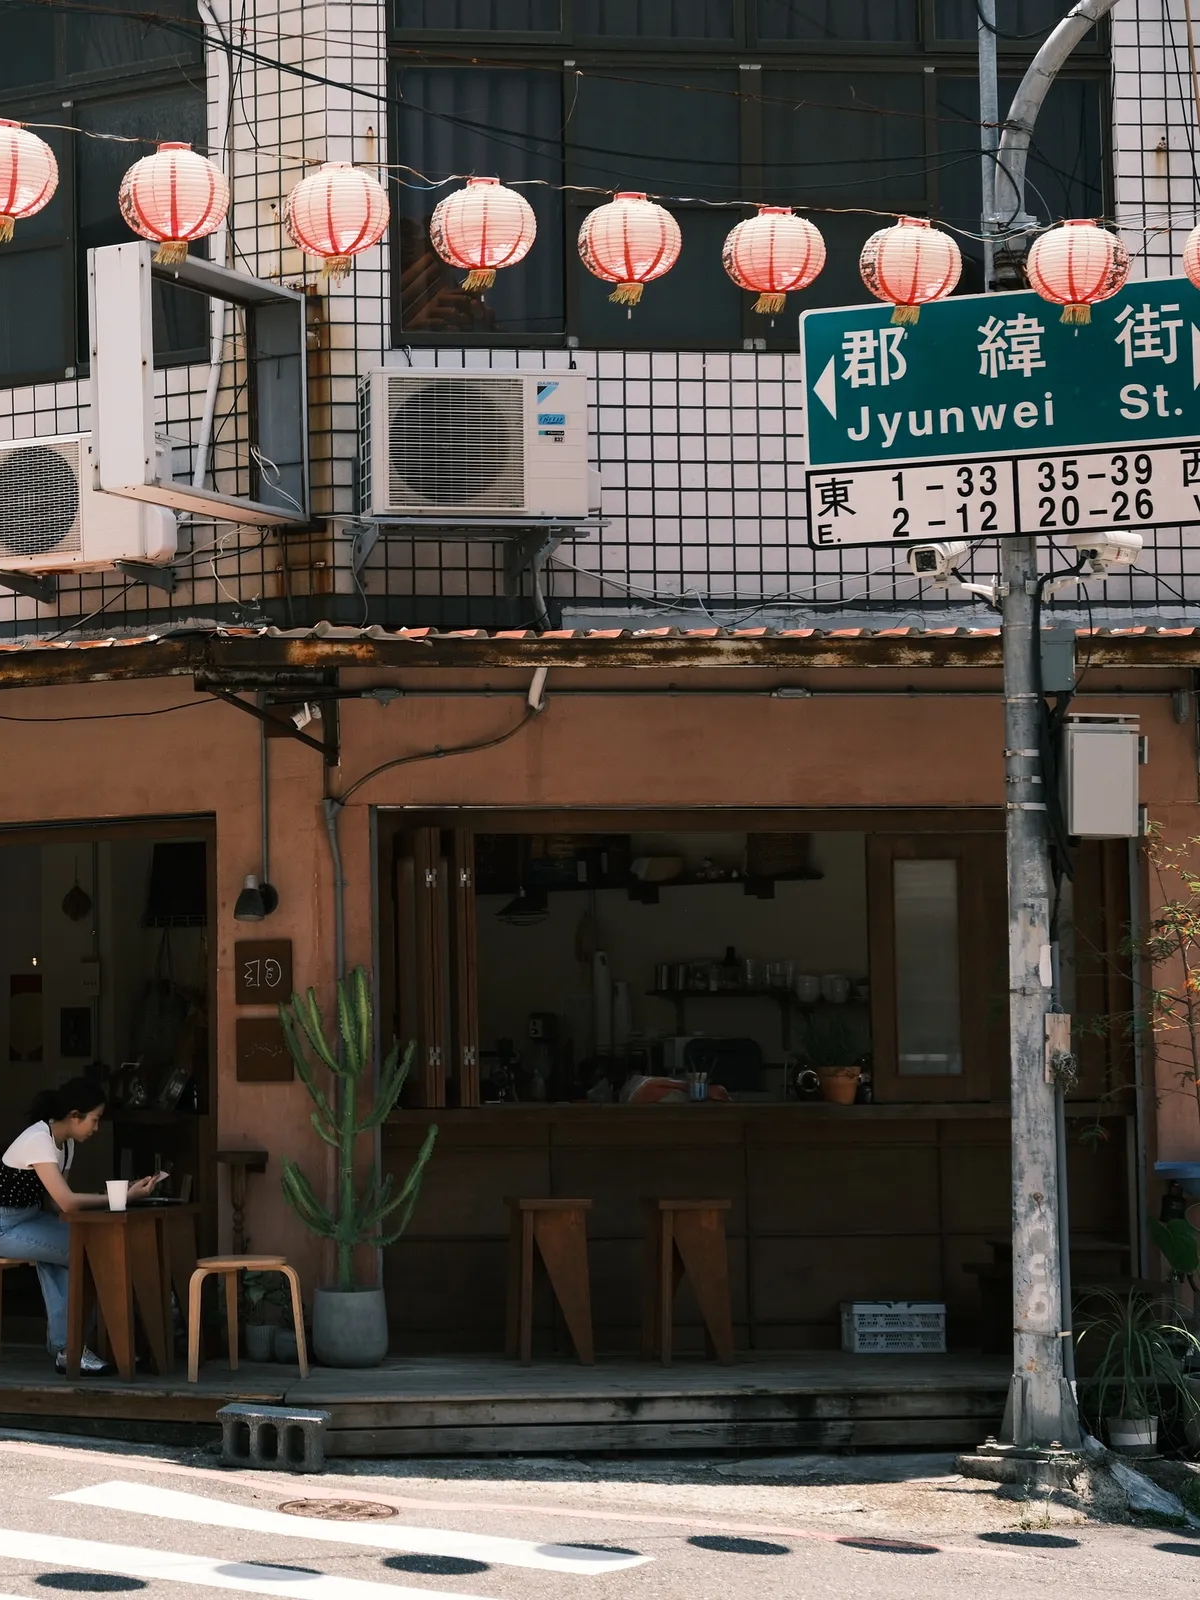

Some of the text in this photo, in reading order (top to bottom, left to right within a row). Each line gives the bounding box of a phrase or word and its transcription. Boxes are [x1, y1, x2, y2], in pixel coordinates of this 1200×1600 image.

[847, 383, 1184, 448] Jyunwei St.
[815, 477, 857, 518] 東
[818, 523, 842, 545] E.
